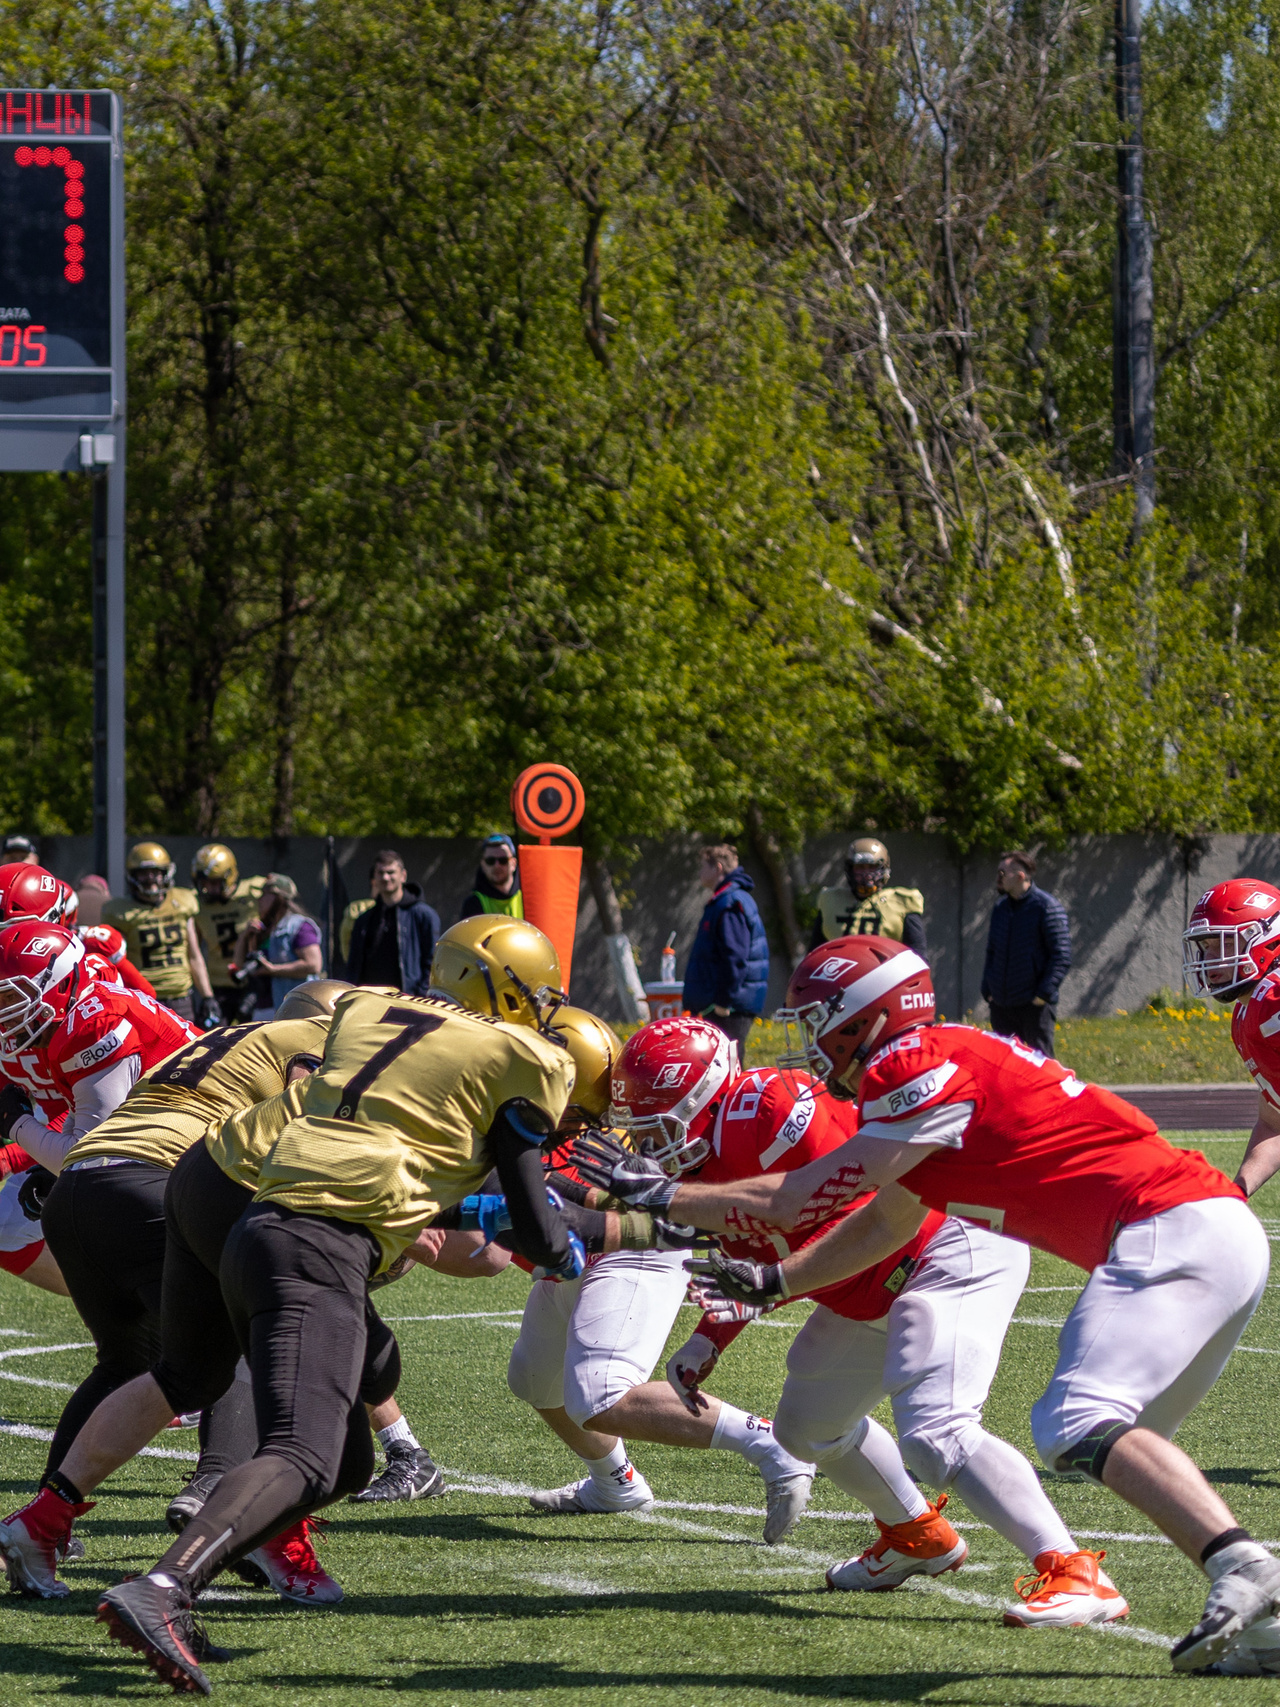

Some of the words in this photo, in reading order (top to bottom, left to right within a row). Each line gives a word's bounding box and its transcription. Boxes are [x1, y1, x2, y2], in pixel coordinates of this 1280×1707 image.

[14, 146, 85, 284] 7
[139, 925, 183, 969] 22
[333, 1006, 447, 1121] 7
[611, 1079, 626, 1102] 62
